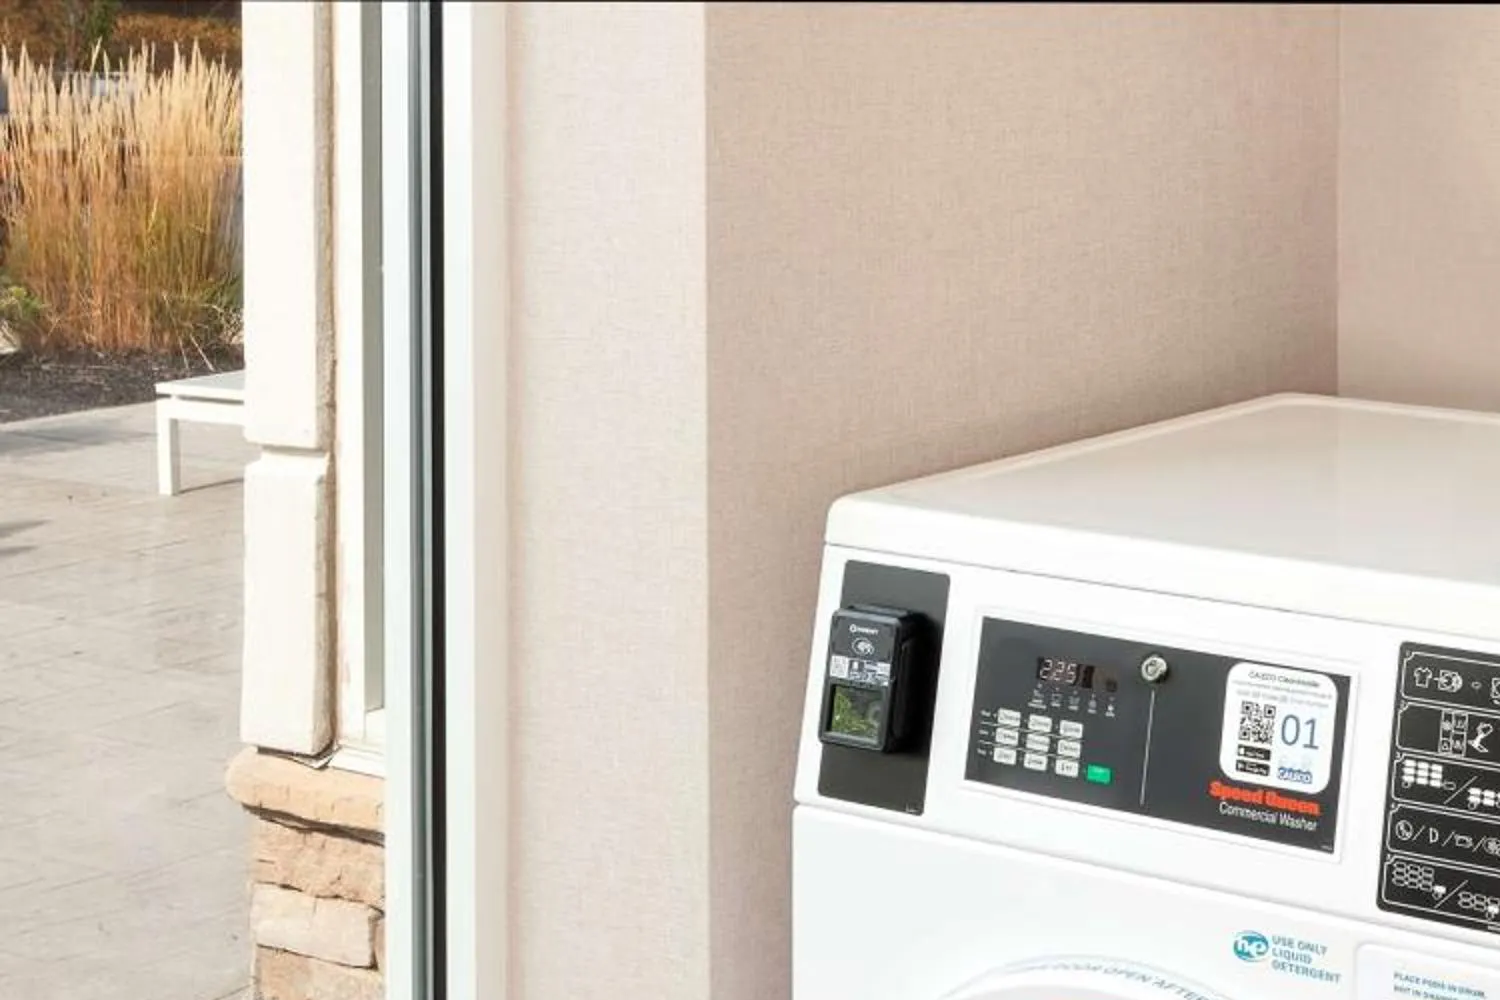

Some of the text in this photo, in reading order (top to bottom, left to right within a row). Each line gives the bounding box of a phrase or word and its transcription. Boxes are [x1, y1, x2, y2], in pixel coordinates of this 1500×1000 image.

[1281, 713, 1319, 749] 01
[1209, 780, 1320, 815] Speed Queen
[1219, 800, 1317, 831] Commercial Washer
[1271, 935, 1327, 955] USE ONLY
[1271, 947, 1312, 964] LIQUID
[1271, 959, 1341, 983] DETERGENT
[1393, 971, 1420, 985] PLACE
